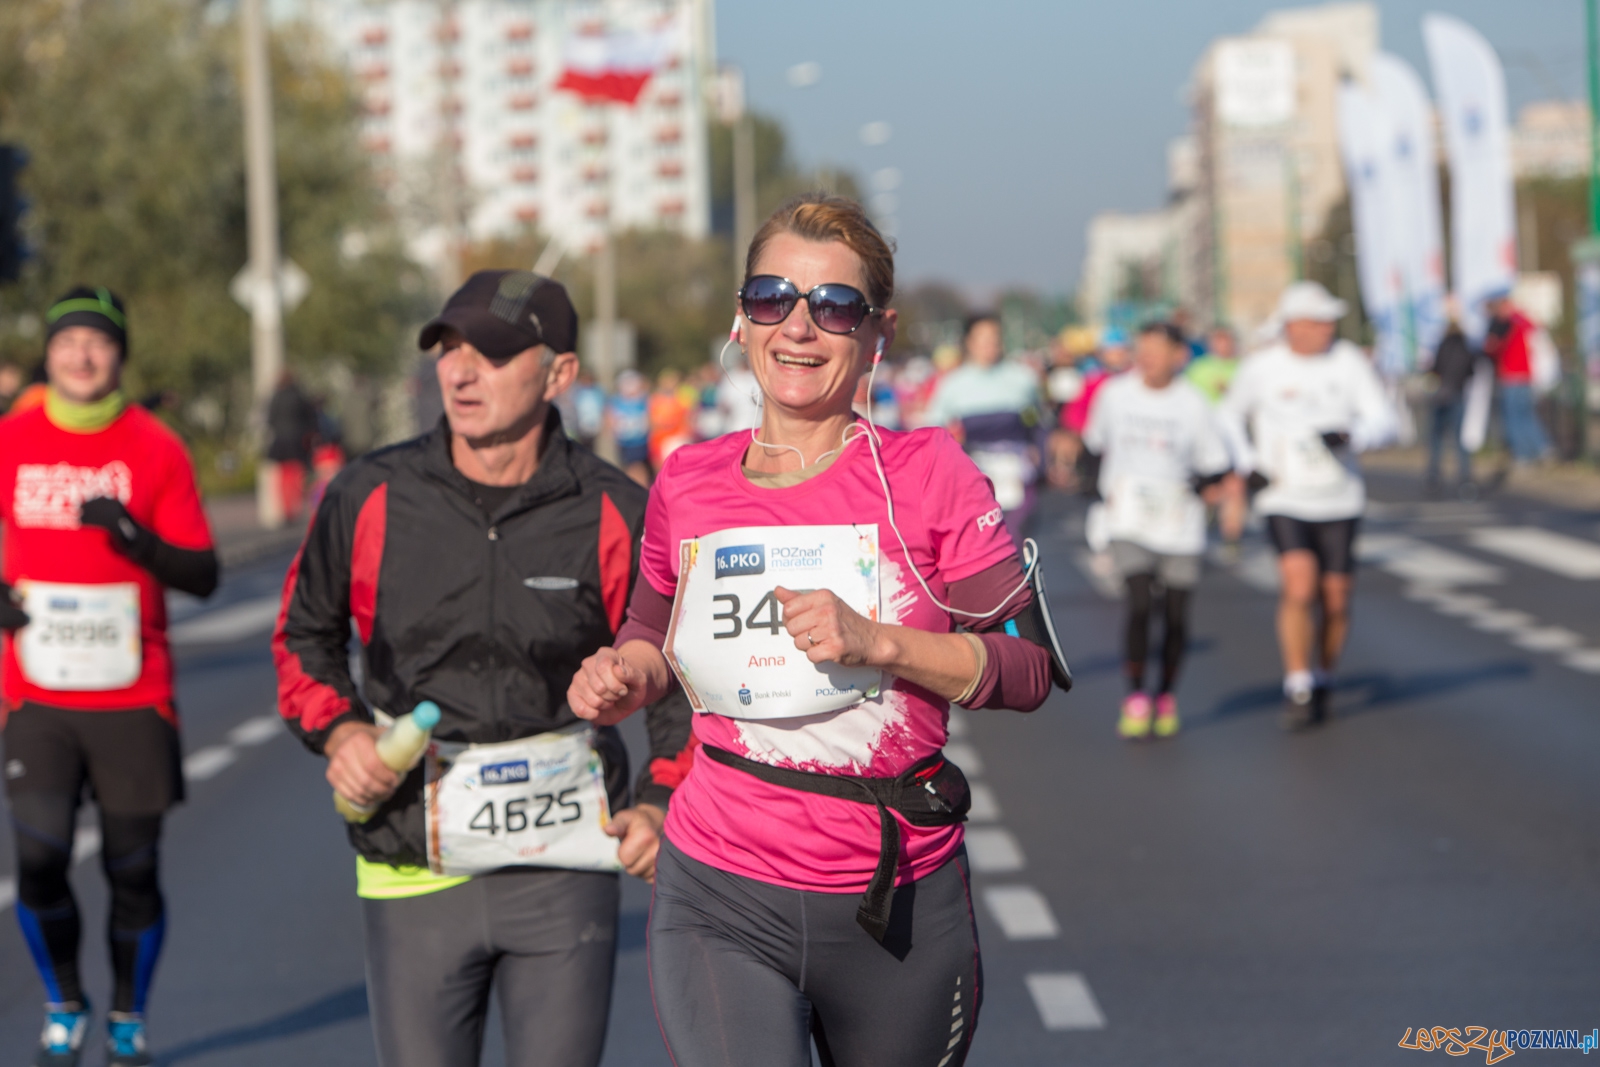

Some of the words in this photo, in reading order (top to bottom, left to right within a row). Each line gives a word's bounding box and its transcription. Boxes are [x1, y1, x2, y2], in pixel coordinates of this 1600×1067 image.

[717, 555, 729, 569] 16.
[730, 553, 760, 568] PKO
[771, 557, 823, 568] maraton
[713, 588, 816, 639] 34
[748, 655, 785, 668] Anna
[754, 691, 770, 699] Bank
[772, 689, 791, 698] Polski
[469, 786, 582, 835] 4625
